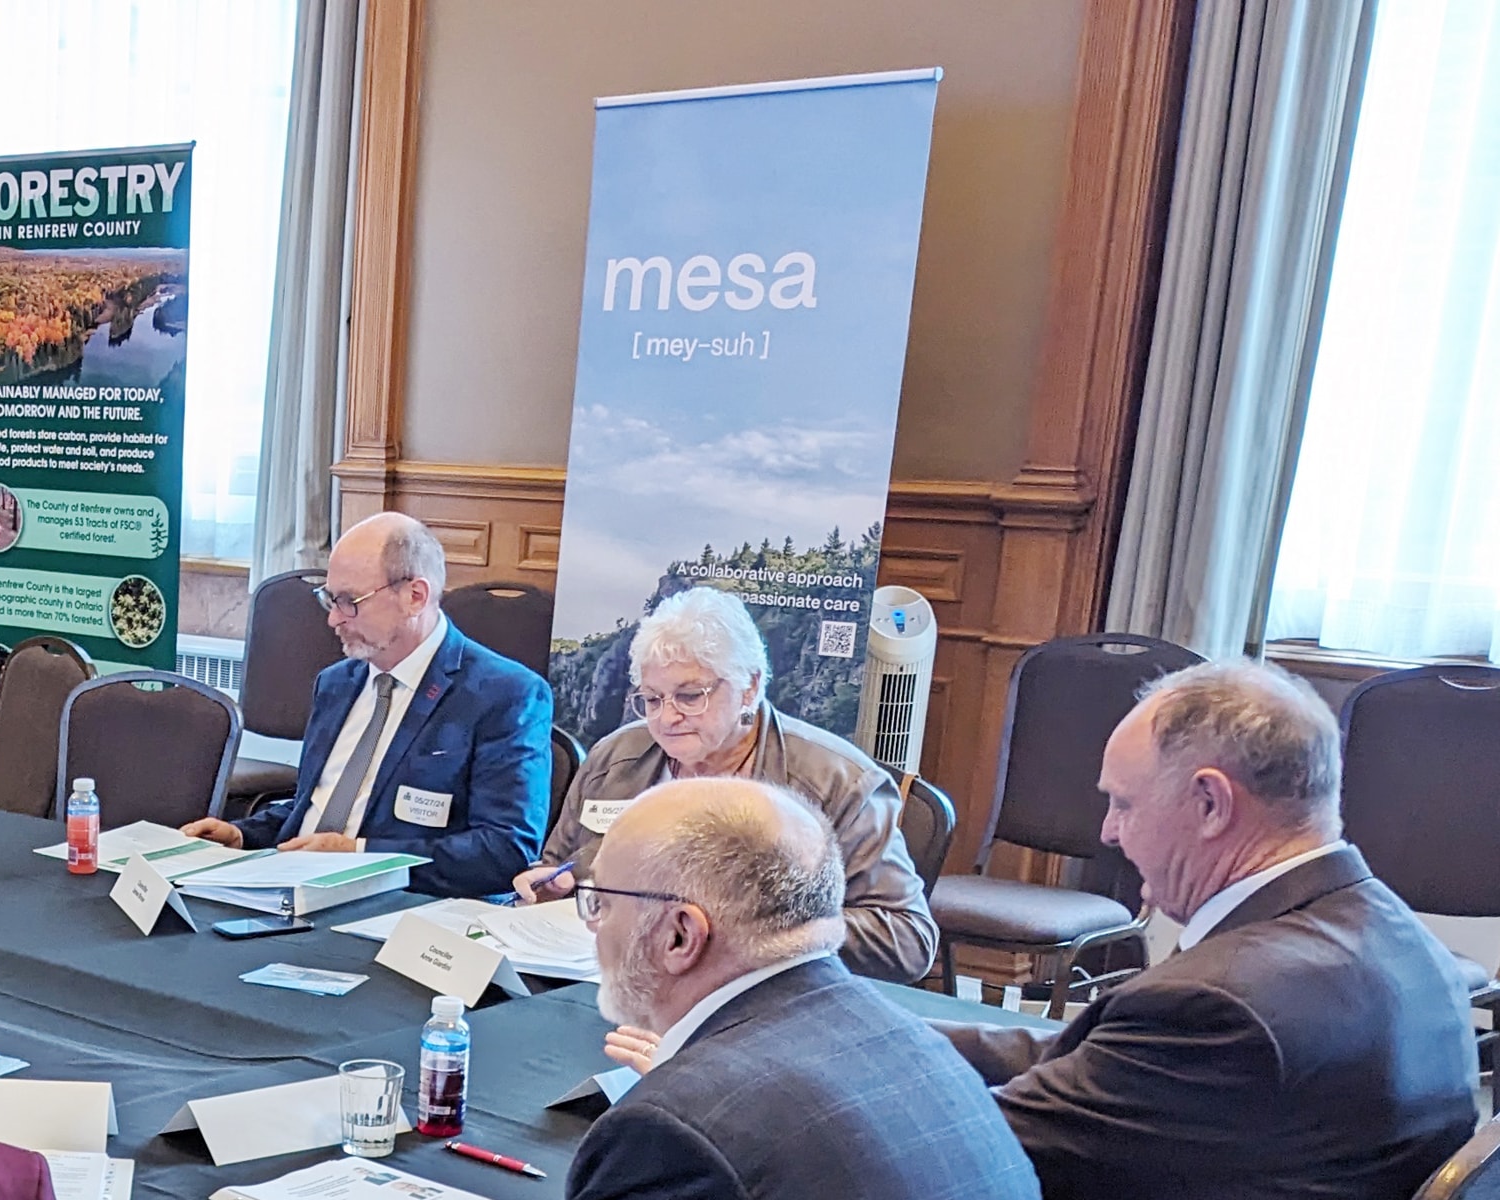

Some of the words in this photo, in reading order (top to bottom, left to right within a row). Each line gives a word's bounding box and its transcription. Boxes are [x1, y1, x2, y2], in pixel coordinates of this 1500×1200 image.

[17, 222, 78, 240] RENFREW
[82, 220, 141, 238] COUNTY
[602, 251, 818, 312] mesa
[42, 386, 97, 401] MANAGED
[99, 387, 122, 401] FOR
[123, 387, 164, 404] TODAY,
[58, 405, 81, 418] AND
[82, 406, 101, 420] THE
[103, 406, 143, 421] FUTURE.
[9, 428, 37, 439] forests
[38, 430, 57, 440] store
[58, 431, 88, 443] carbon,
[89, 432, 121, 444] provide
[122, 433, 153, 444] habitat
[155, 434, 168, 445] for
[10, 443, 41, 455] protect
[42, 444, 64, 455] water
[65, 444, 81, 456] and
[82, 445, 98, 457] soil,
[99, 446, 117, 458] and
[118, 447, 155, 460] produce
[12, 457, 48, 469] products
[49, 458, 57, 469] to
[58, 459, 79, 470] meet
[80, 460, 116, 474] society's
[116, 462, 145, 474] needs.
[27, 499, 41, 510] The
[42, 501, 70, 514] County
[71, 502, 79, 513] of
[80, 503, 112, 514] Renfrew
[114, 506, 135, 516] owns
[137, 507, 154, 517] and
[37, 515, 73, 528] manages
[74, 516, 85, 527] 53
[86, 517, 109, 528] Tracts
[110, 518, 119, 529] of
[59, 530, 91, 542] certified
[92, 531, 117, 543] forest.
[676, 563, 688, 576] A
[690, 563, 788, 584] collaborative
[788, 573, 863, 588] approach
[26, 580, 54, 595] County
[54, 582, 60, 593] is
[61, 584, 75, 595] the
[75, 585, 102, 600] largest
[38, 595, 65, 610] county
[65, 598, 73, 609] in
[73, 599, 104, 613] Ontario
[824, 599, 860, 613] care
[6, 605, 12, 616] is
[13, 608, 35, 619] more
[36, 609, 53, 621] than
[54, 610, 71, 623] 70%
[71, 612, 104, 627] forested.
[409, 807, 438, 817] VISITOR
